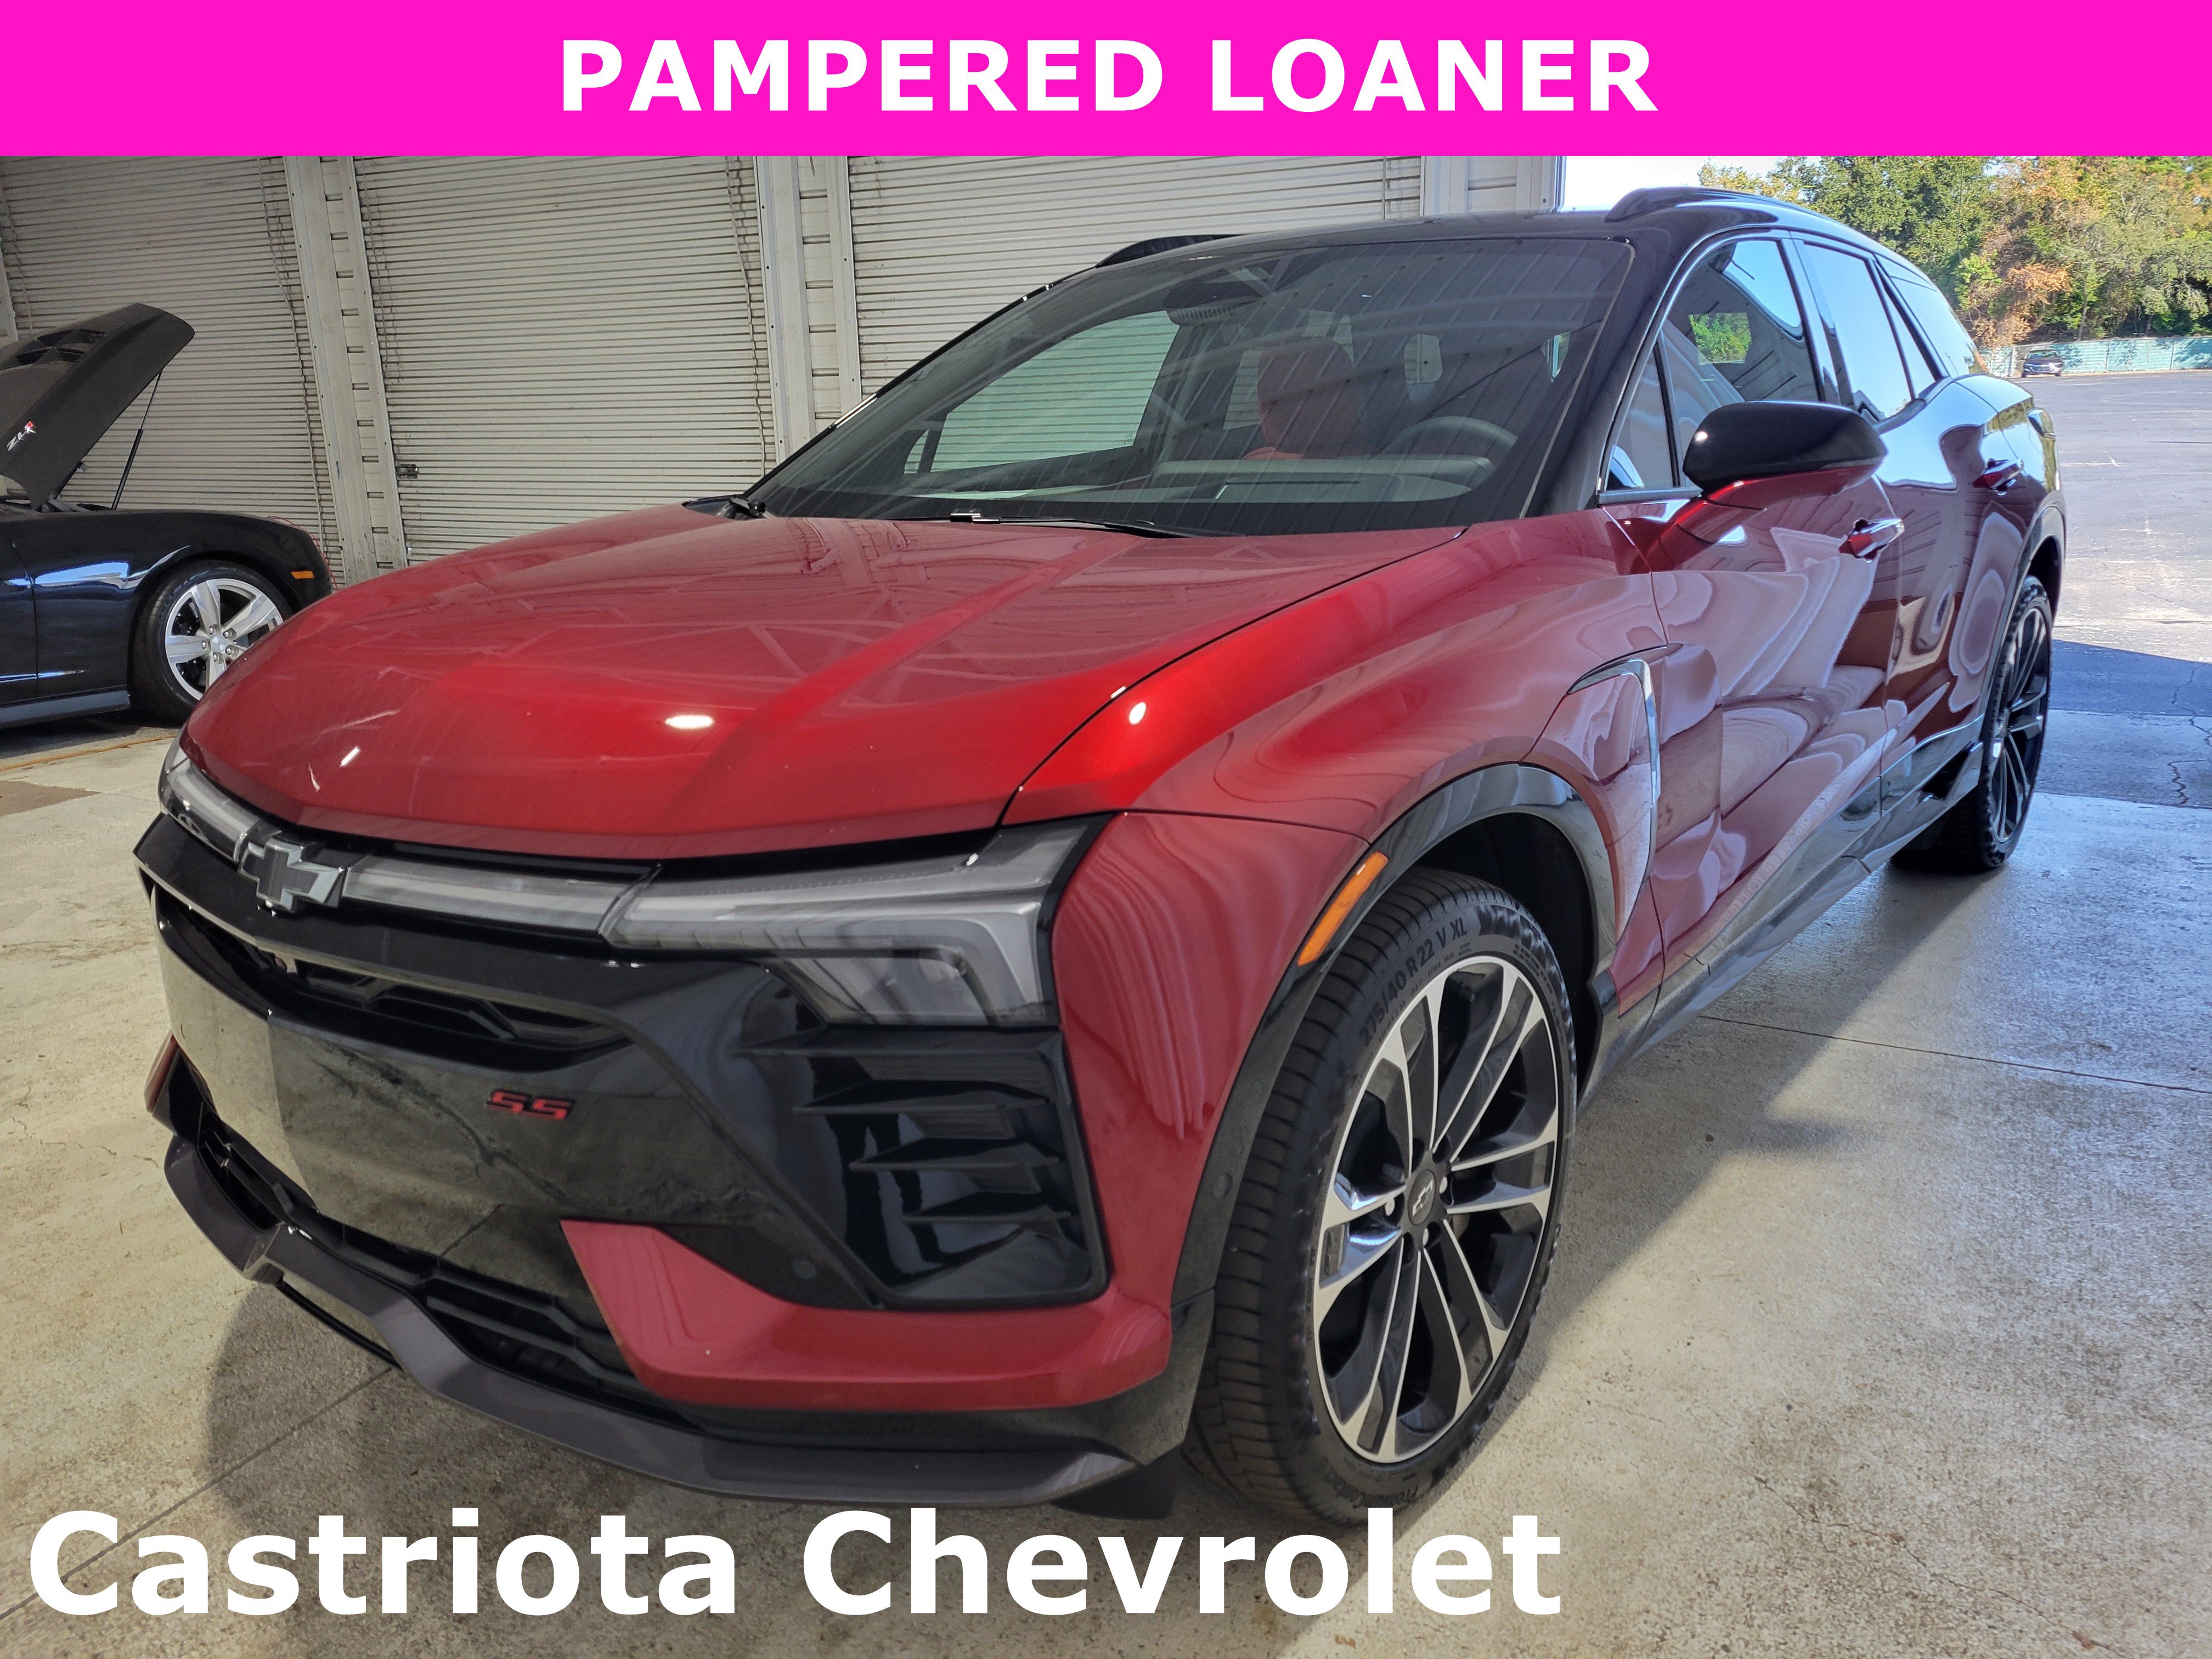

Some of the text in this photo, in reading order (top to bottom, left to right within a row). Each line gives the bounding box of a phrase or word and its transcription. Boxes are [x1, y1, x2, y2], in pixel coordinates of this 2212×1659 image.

[1359, 968, 1407, 1047] 275/40
[1435, 926, 1447, 949] V
[1449, 917, 1468, 941] XL
[487, 1091, 573, 1120] SS
